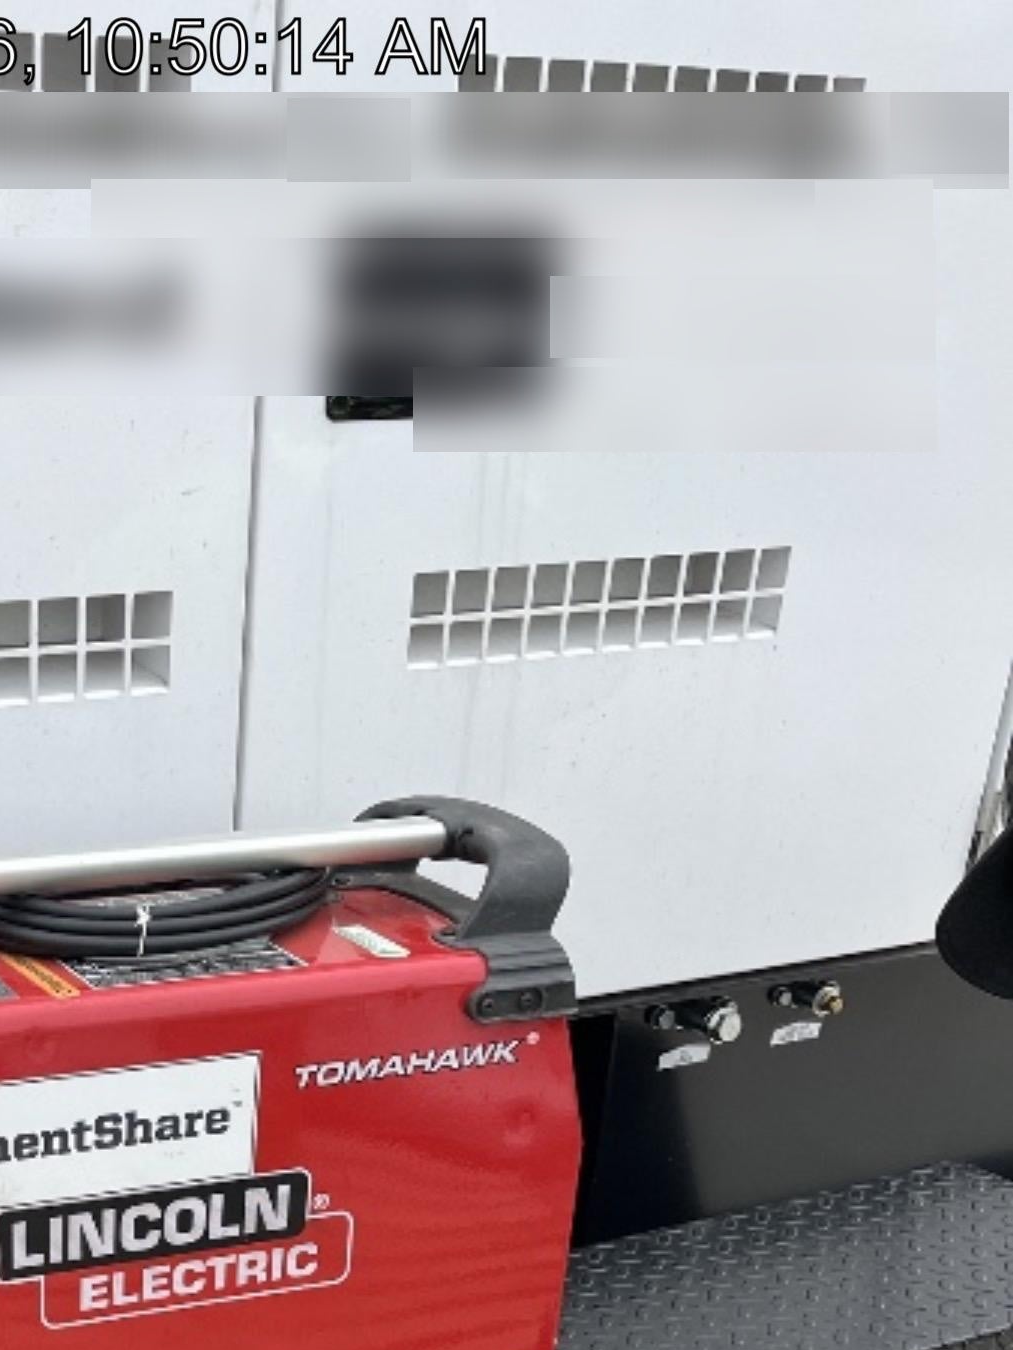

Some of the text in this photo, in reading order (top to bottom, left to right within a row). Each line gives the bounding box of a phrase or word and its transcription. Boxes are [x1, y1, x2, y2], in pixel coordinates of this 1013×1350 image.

[295, 1039, 520, 1089] TOMAHAWK
[11, 1184, 291, 1270] LINCOLN
[78, 1242, 318, 1312] ELECTRIC
